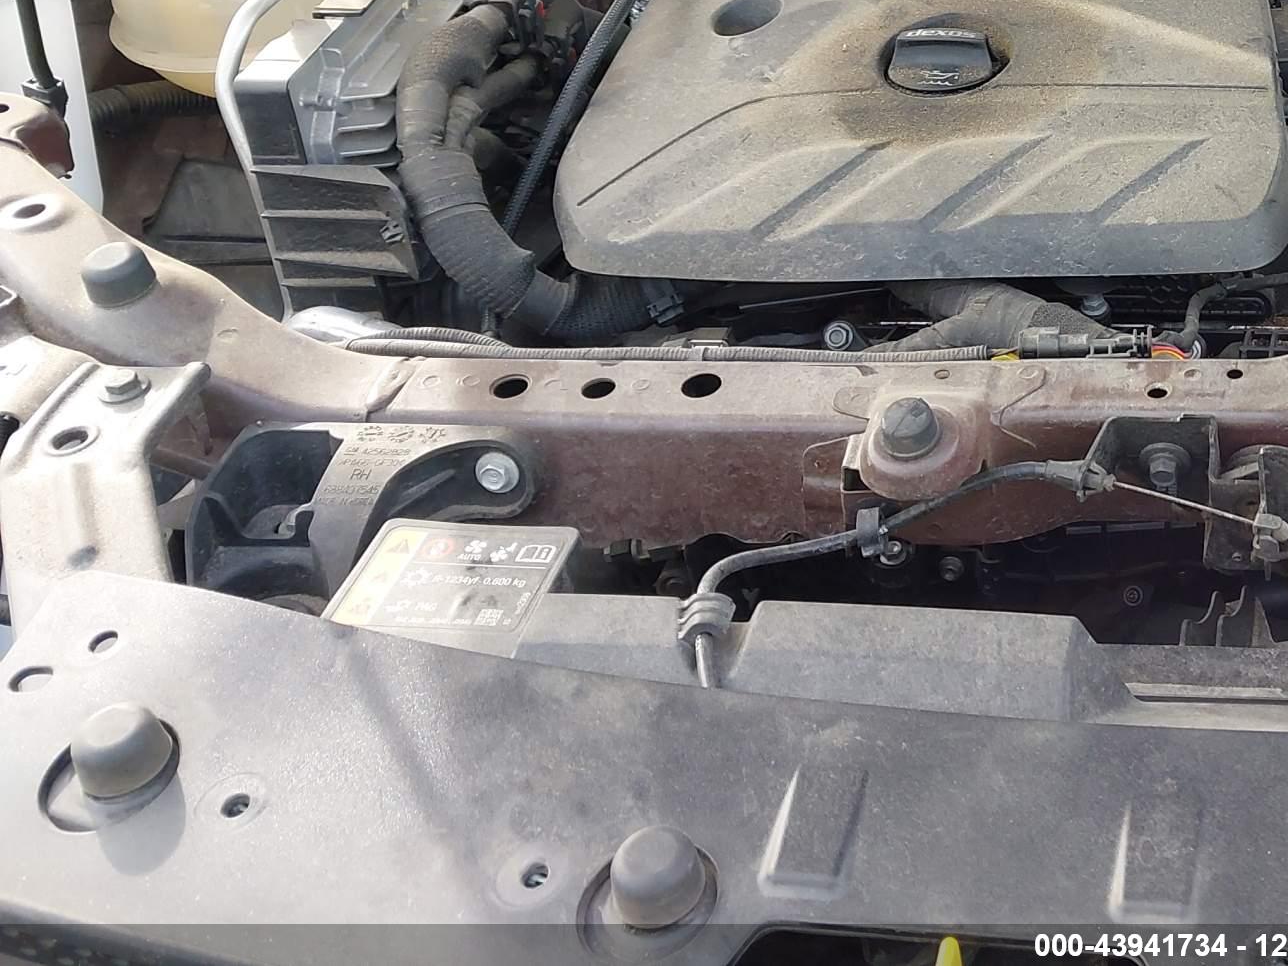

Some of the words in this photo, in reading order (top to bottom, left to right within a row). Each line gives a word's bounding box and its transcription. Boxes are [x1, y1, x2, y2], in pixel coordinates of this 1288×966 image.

[905, 28, 976, 38] dexos
[457, 553, 482, 561] AUTO
[512, 577, 527, 588] kg
